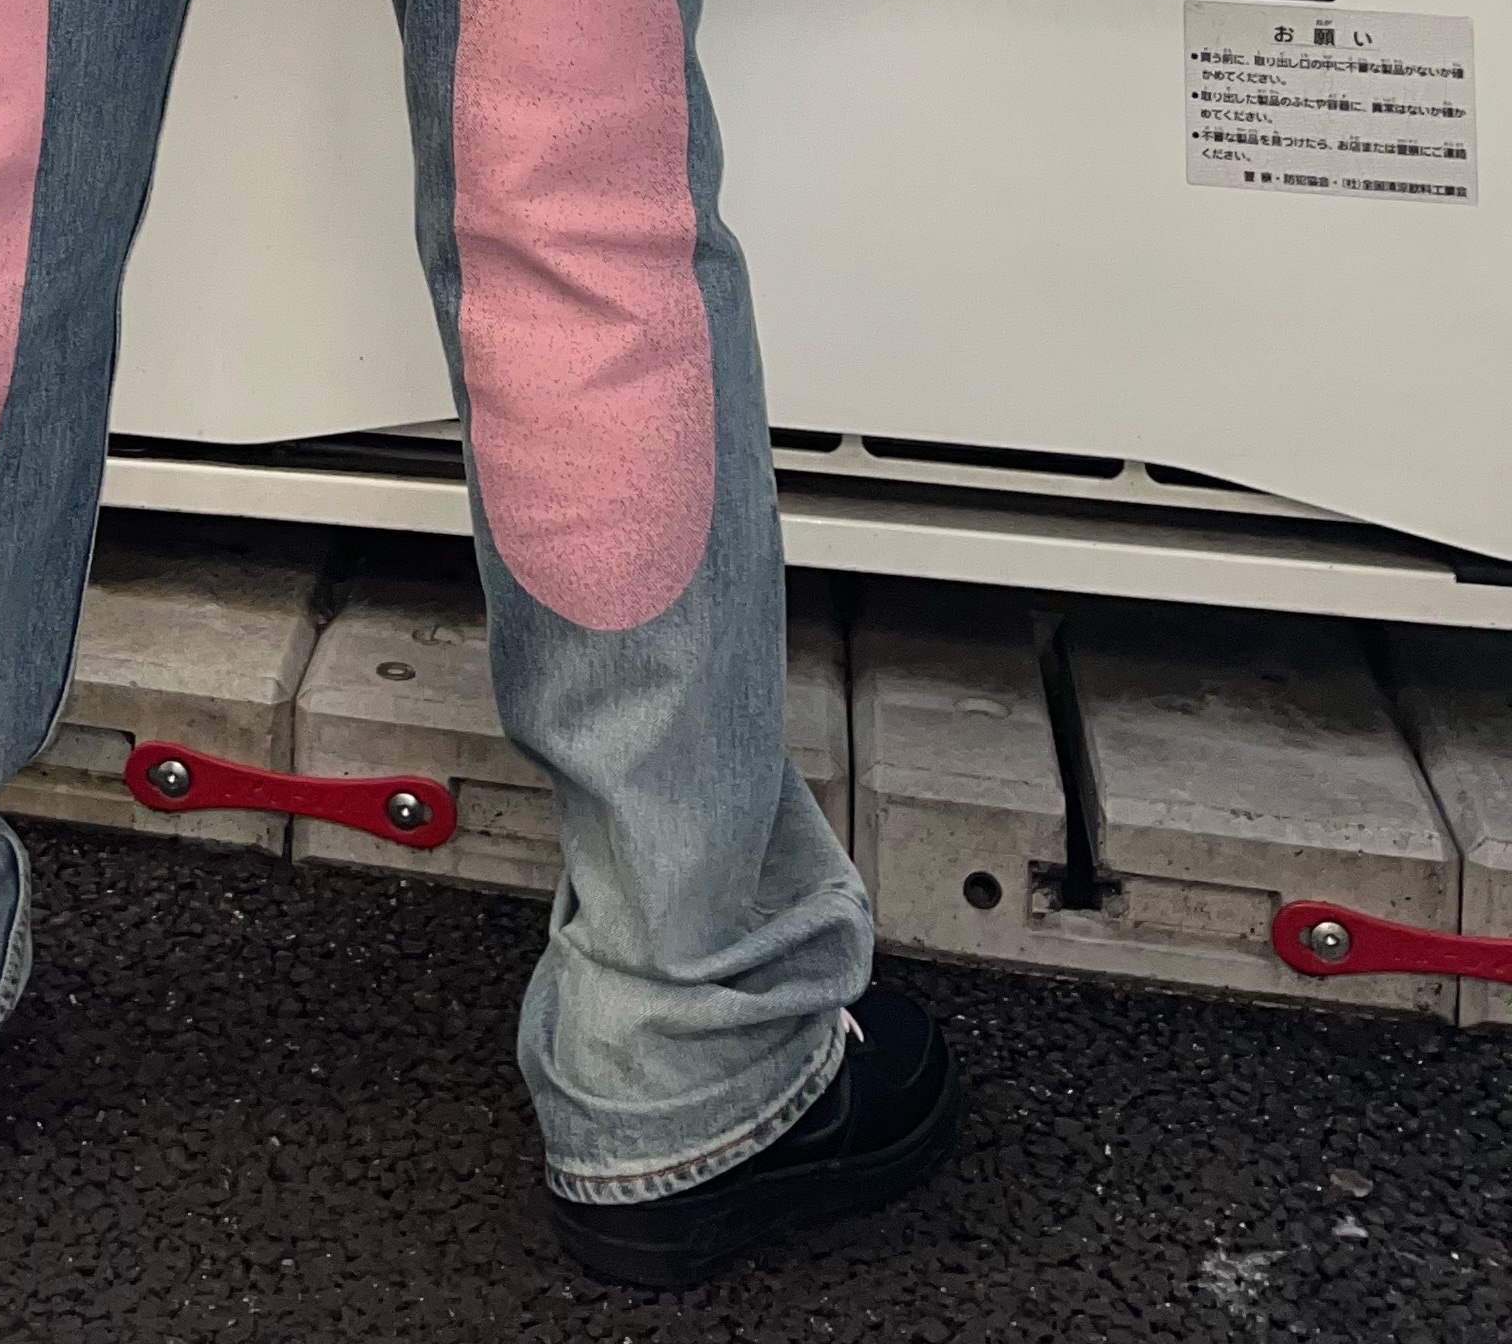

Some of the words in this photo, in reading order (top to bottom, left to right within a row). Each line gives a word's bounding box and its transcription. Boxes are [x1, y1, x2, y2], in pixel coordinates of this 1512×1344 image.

[1274, 26, 1373, 46] お願い
[1202, 70, 1287, 85] かめてください。
[1200, 108, 1273, 124] めてください。
[1202, 148, 1251, 162] ください。
